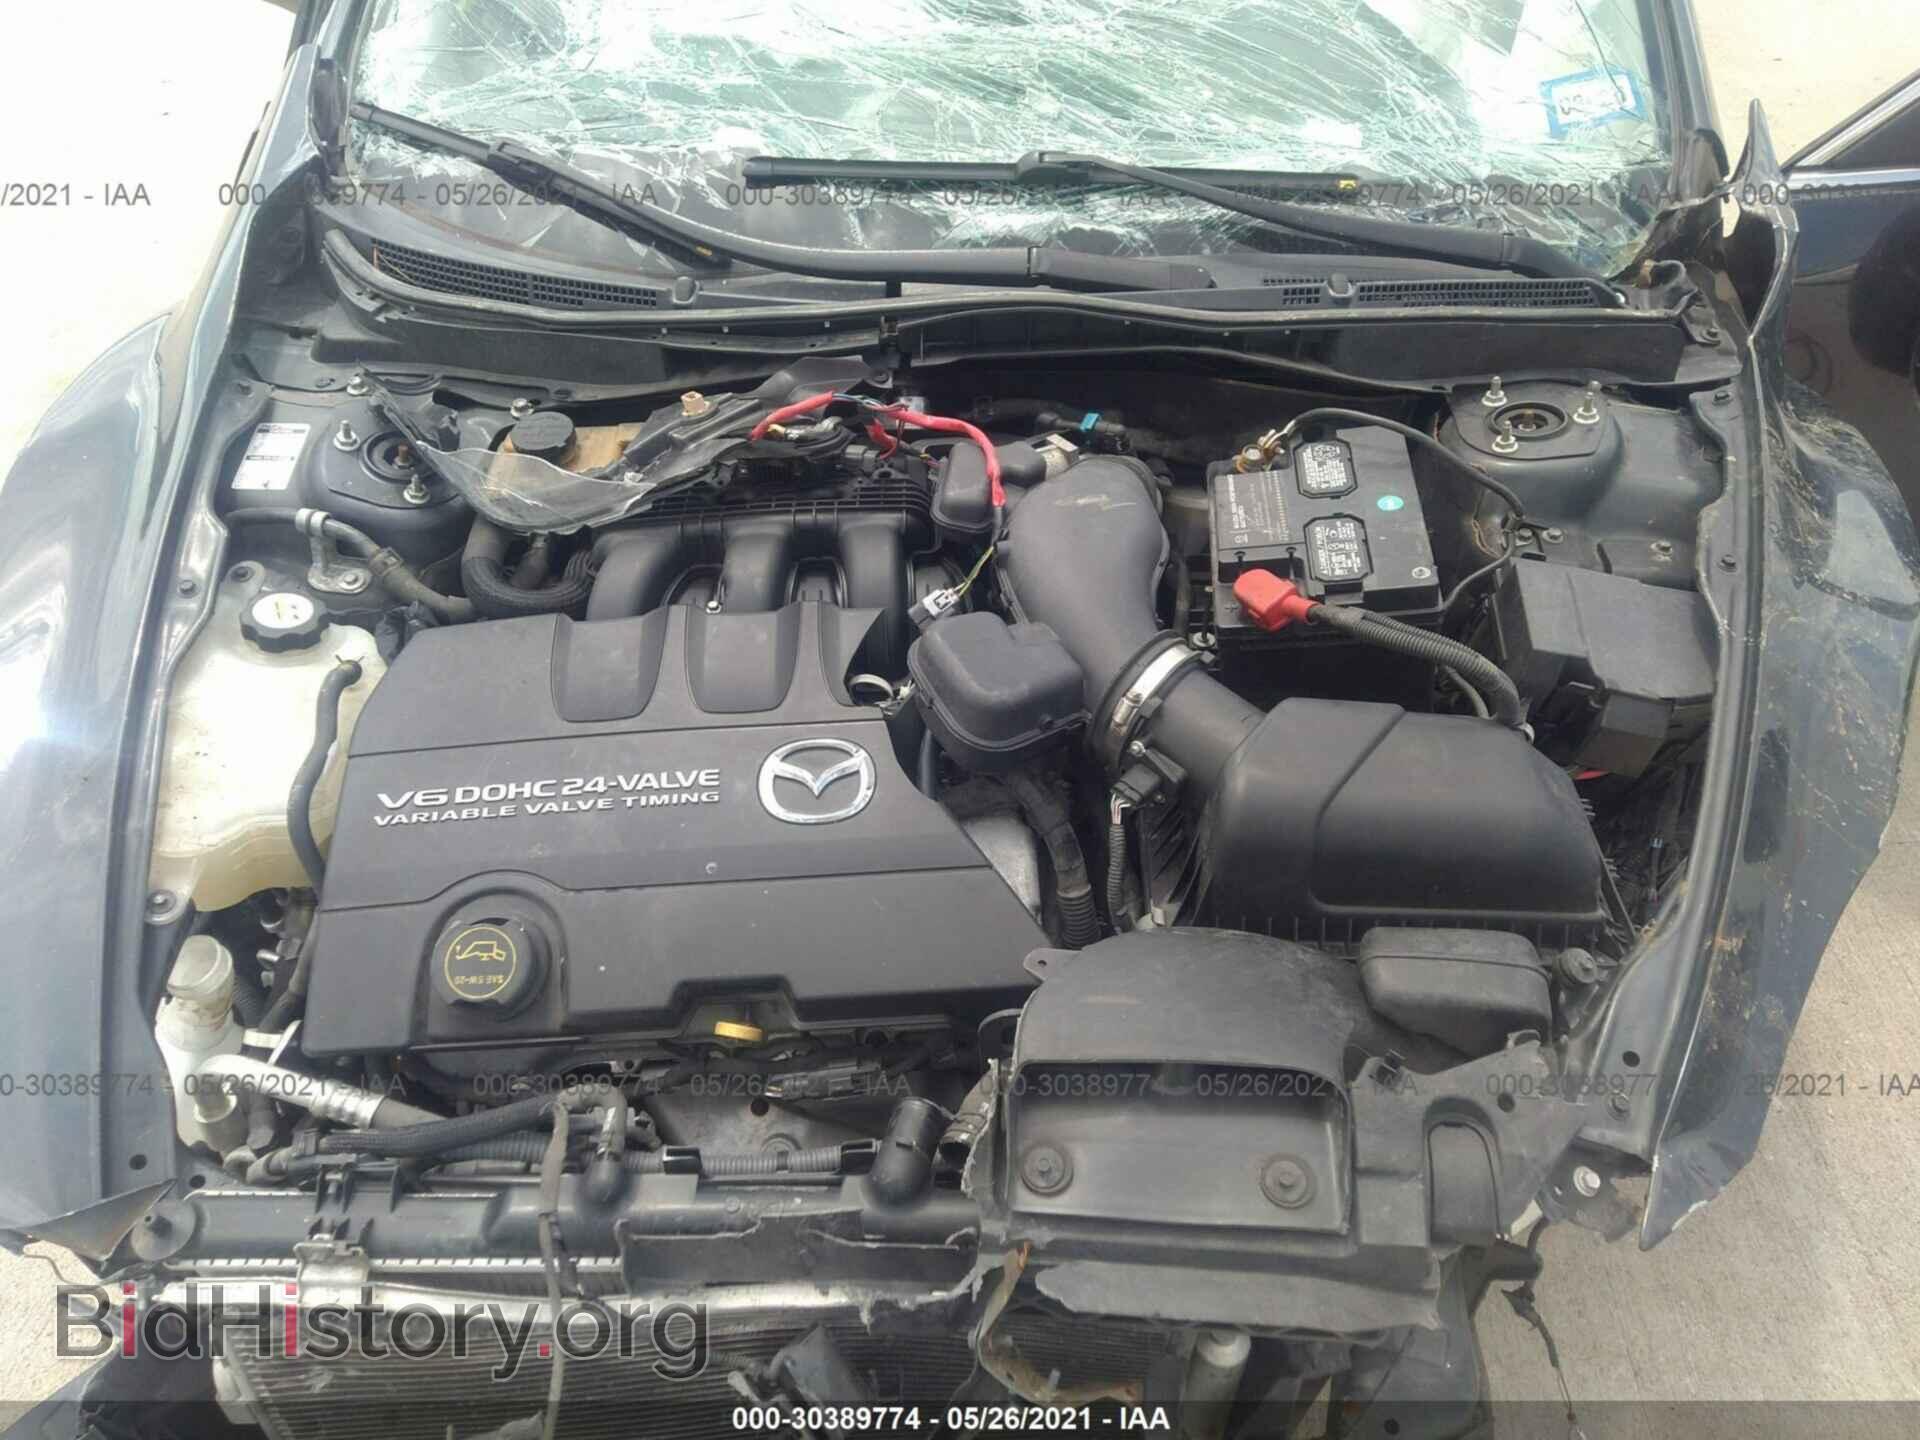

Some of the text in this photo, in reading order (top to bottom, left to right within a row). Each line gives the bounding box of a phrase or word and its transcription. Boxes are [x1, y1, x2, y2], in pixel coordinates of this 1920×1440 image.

[377, 769, 721, 810] V6 DOHC 24-VALVE
[373, 791, 721, 827] VARIABLE VALVE TIMING
